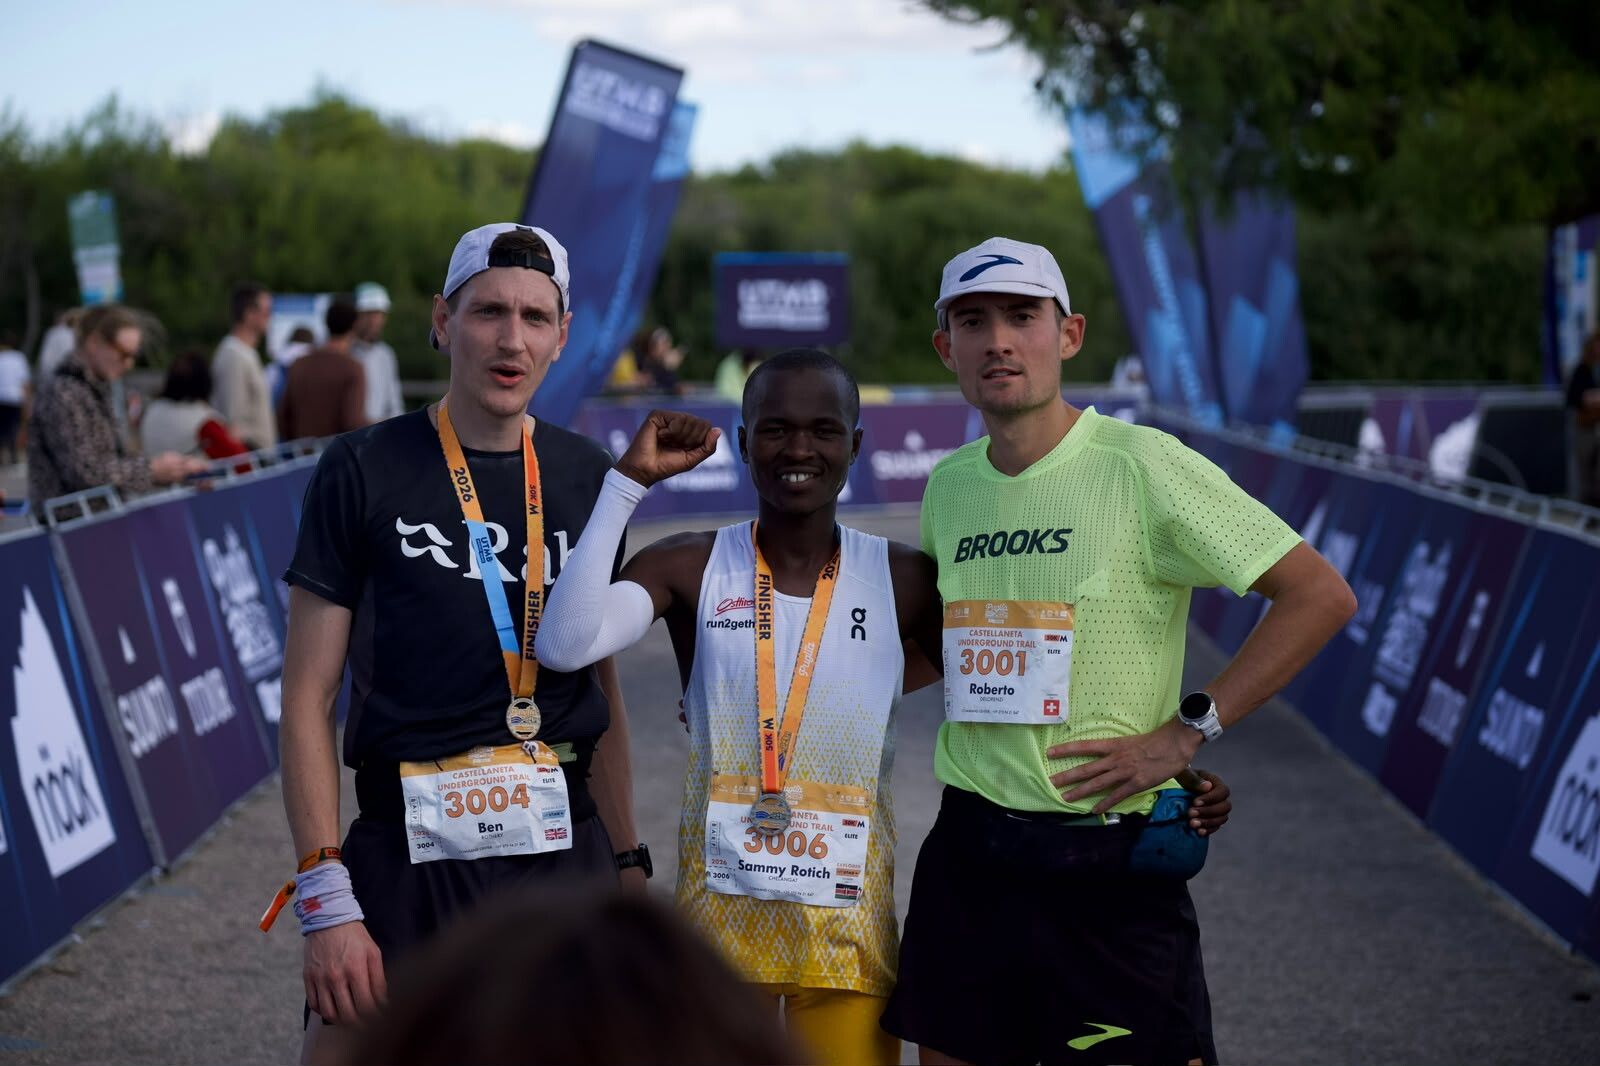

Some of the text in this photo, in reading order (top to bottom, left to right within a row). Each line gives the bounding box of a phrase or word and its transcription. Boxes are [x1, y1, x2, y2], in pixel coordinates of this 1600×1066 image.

[872, 449, 955, 480] SUUN
[453, 466, 474, 503] 2026
[480, 537, 494, 562] UTMB
[953, 528, 1074, 564] BROOKS
[821, 553, 841, 580] 20
[758, 573, 772, 641] FINISHER
[525, 590, 541, 662] FINISHER
[706, 618, 755, 631] run2geth
[969, 629, 1023, 638] CASTELLANETA
[957, 639, 1037, 648] UNDERGROUND TRAIL
[959, 648, 1027, 677] 3001
[969, 682, 1015, 696] Roberto
[437, 773, 531, 792] UNDERGROUND TRAIL
[452, 766, 515, 780] CASTELLANETA
[444, 783, 531, 818] 3004
[477, 822, 504, 833] Ben
[811, 822, 834, 832] TRAIL
[416, 841, 435, 850] 3004
[743, 826, 829, 860] 3006
[711, 858, 727, 866] 2026
[738, 859, 831, 880] Sammy Rotich
[712, 872, 730, 880] 3006
